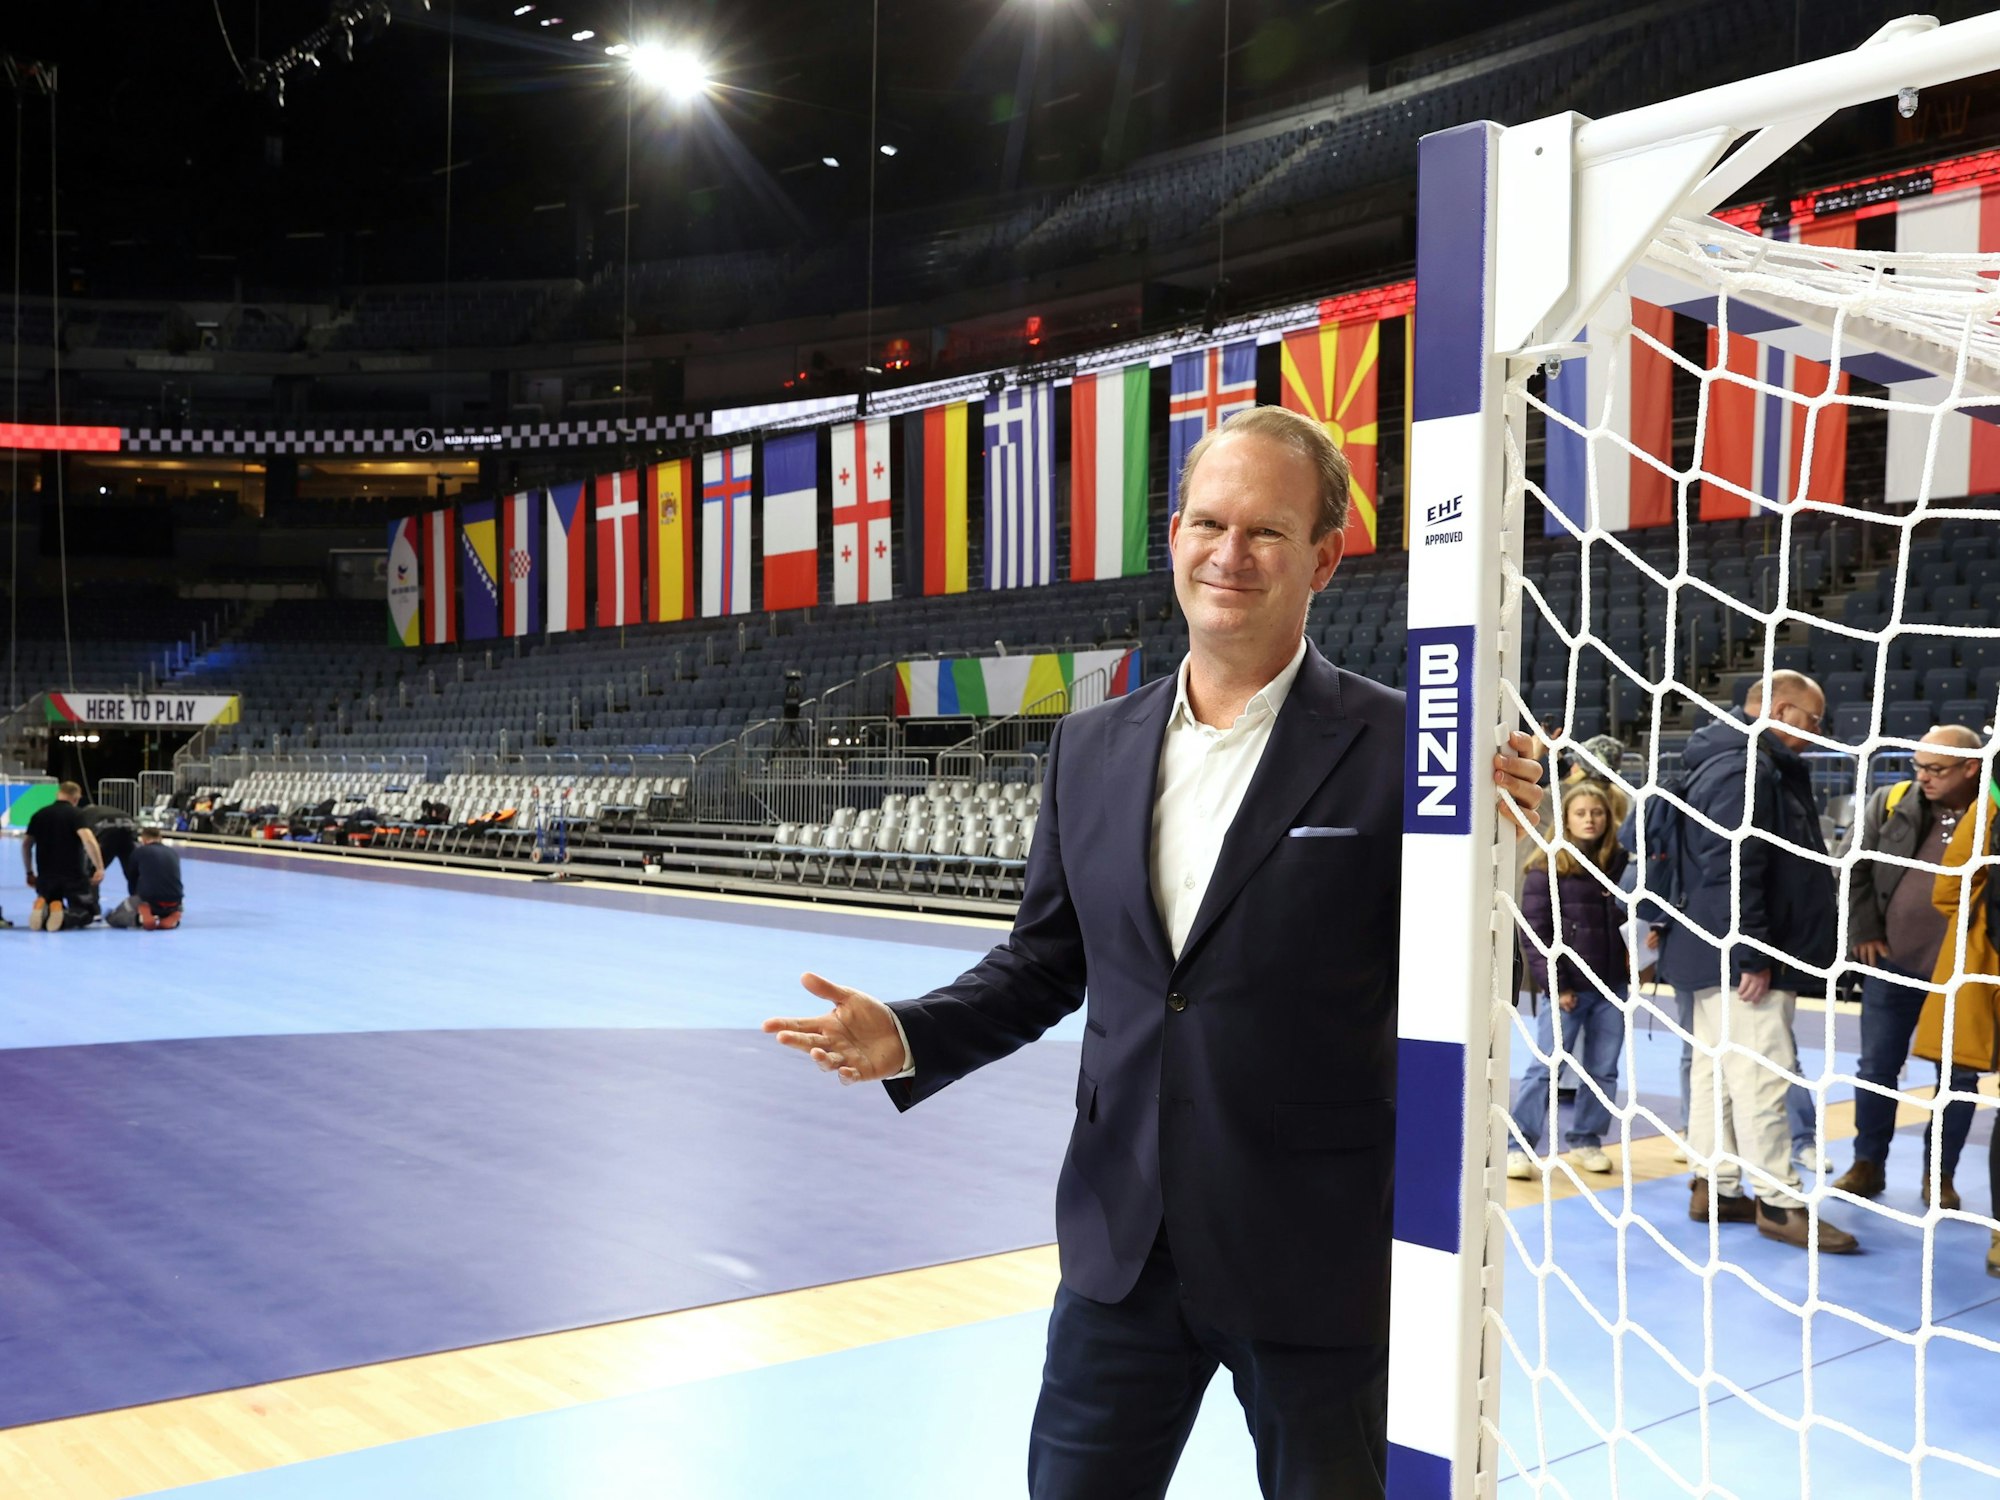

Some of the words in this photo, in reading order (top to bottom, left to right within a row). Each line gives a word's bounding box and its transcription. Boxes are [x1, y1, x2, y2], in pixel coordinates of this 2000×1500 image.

[1427, 494, 1463, 522] EHF
[1425, 531, 1463, 546] APPROVED
[87, 699, 124, 720] HERE
[131, 700, 150, 720] TO
[156, 700, 195, 721] PLAY
[1417, 643, 1459, 816] BENZ
